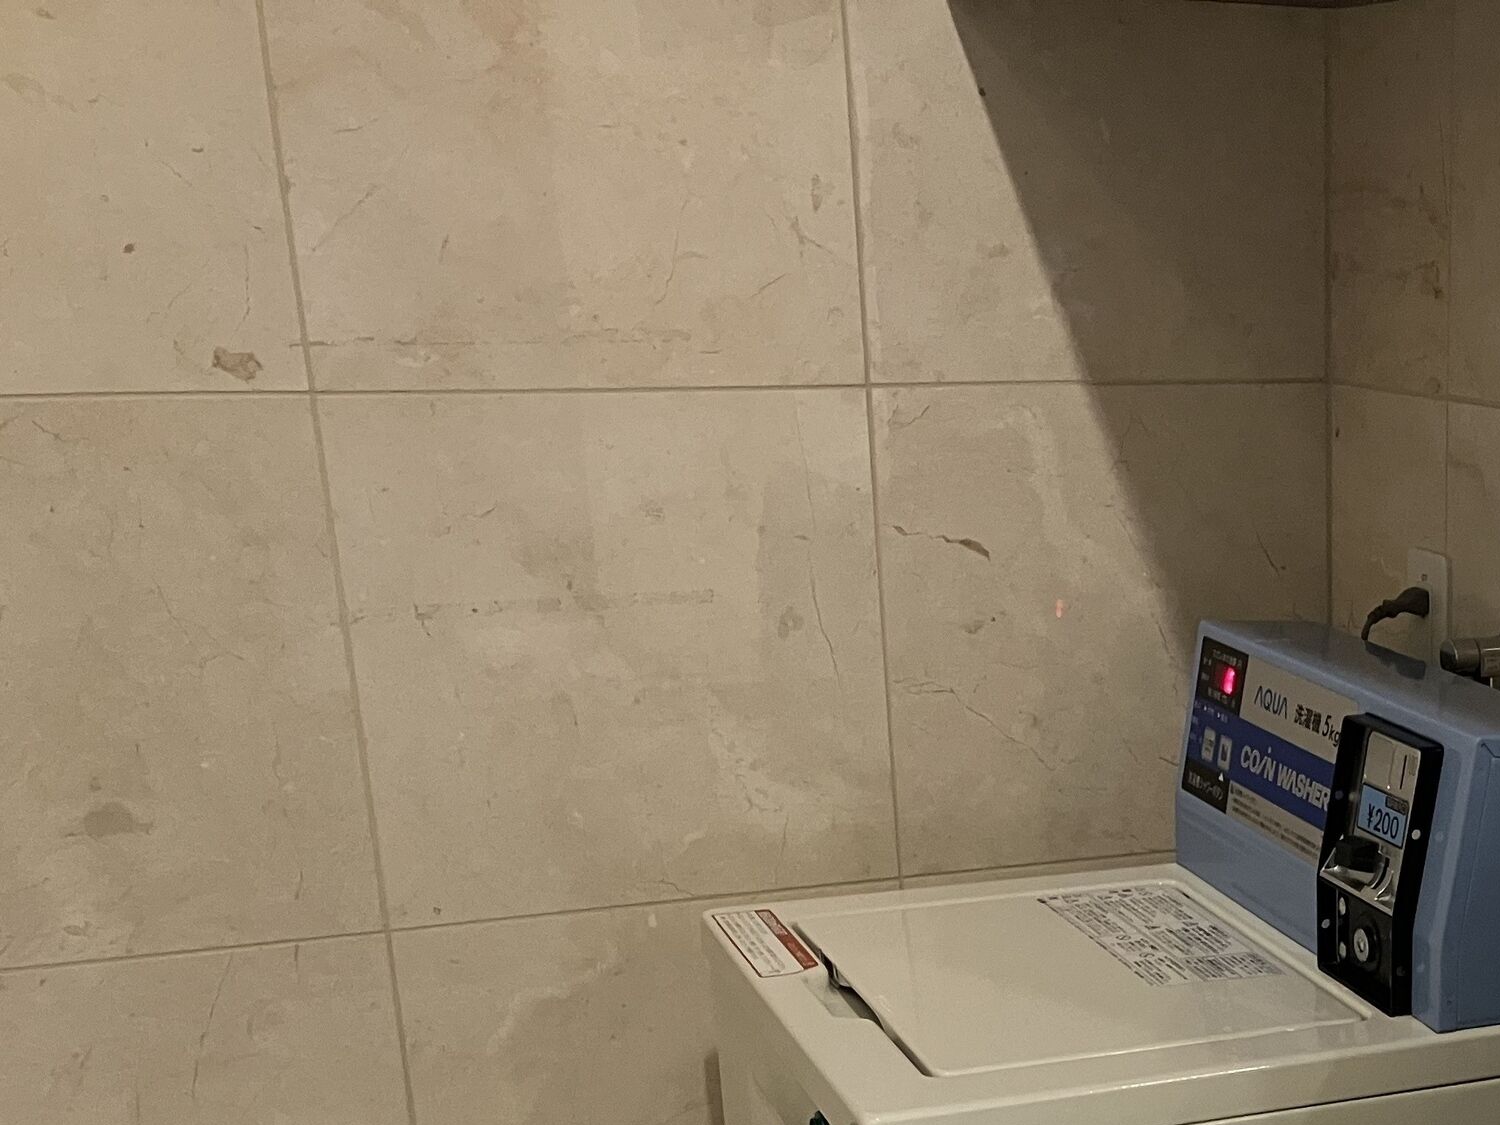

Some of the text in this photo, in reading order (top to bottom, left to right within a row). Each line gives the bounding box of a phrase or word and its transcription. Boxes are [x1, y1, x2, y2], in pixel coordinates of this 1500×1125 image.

[1254, 685, 1288, 719] AQUA
[1240, 745, 1332, 812] COIN WASHER
[1367, 803, 1400, 840] ¥200
